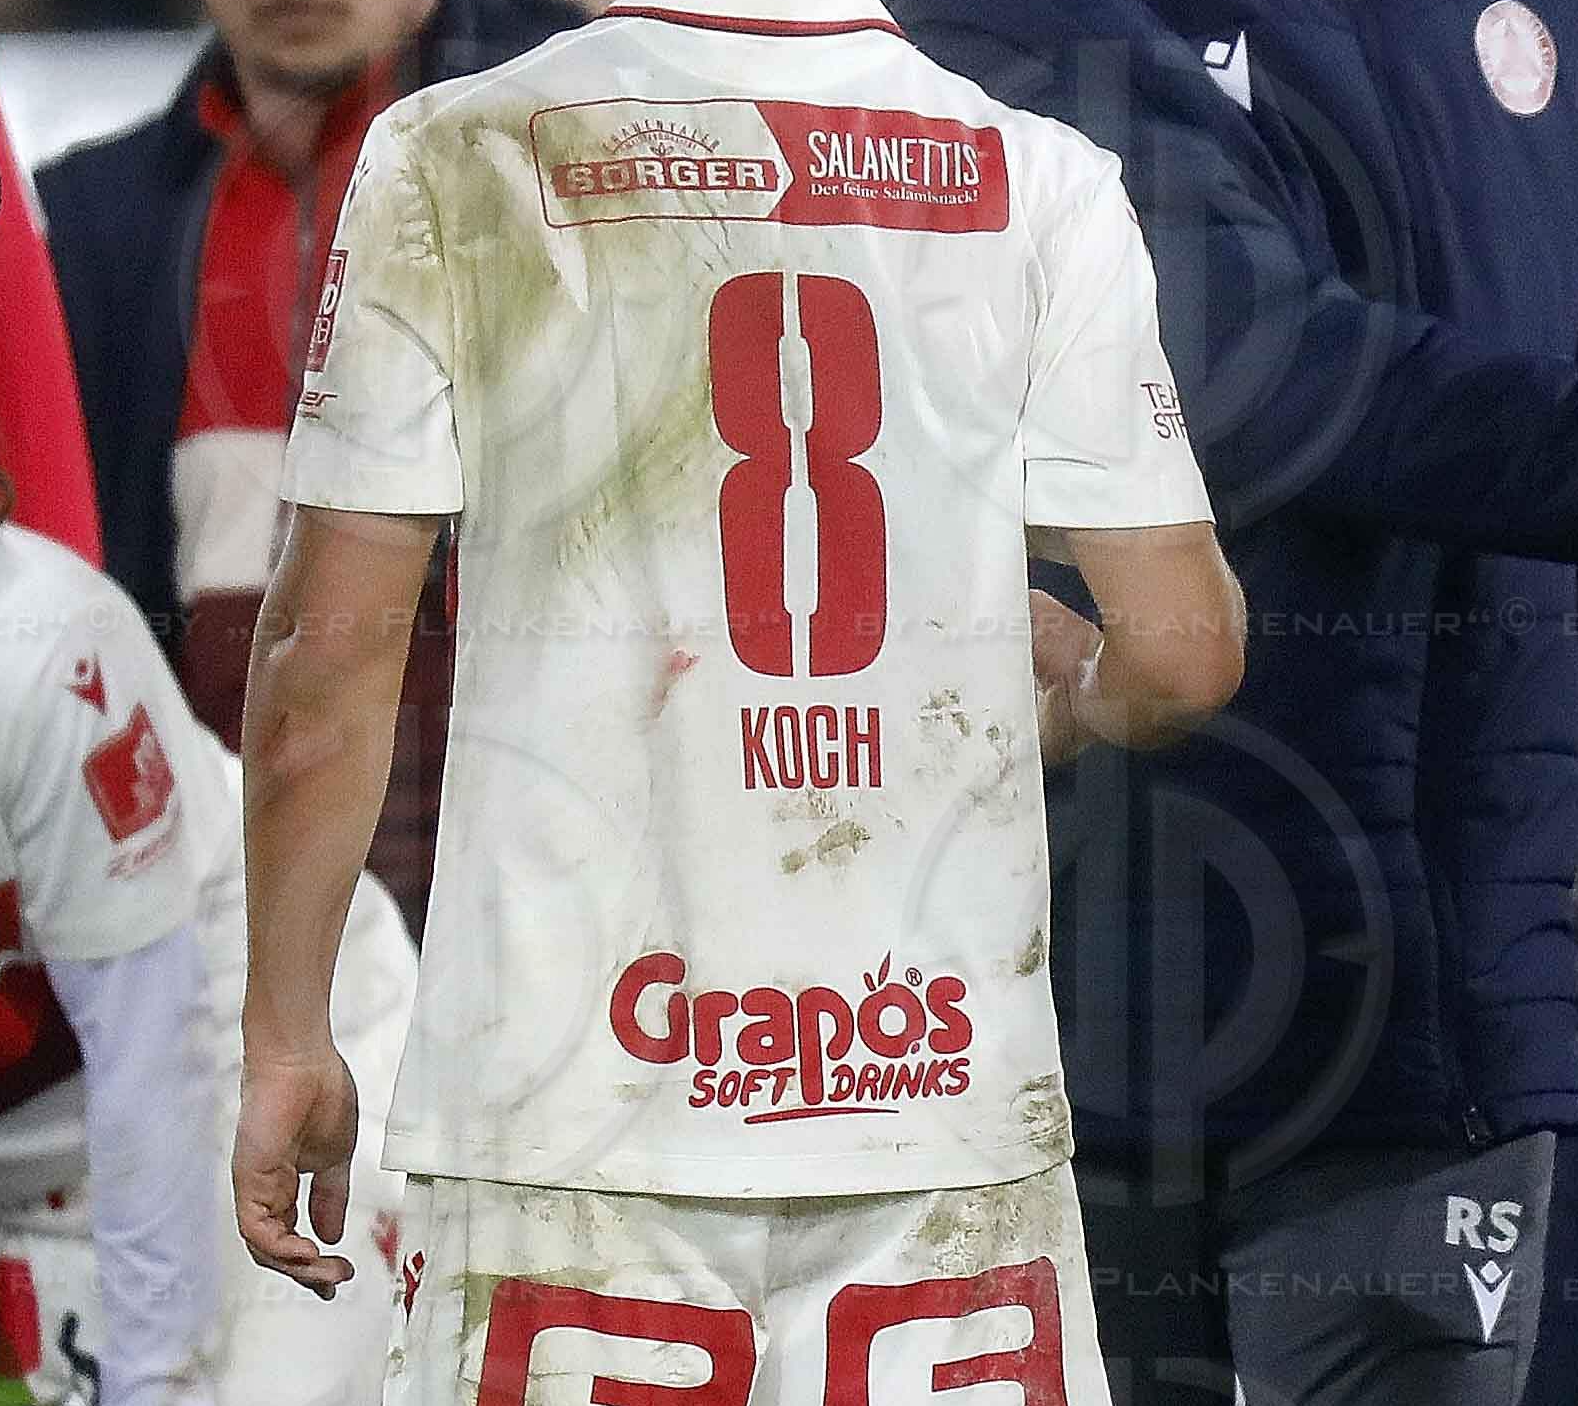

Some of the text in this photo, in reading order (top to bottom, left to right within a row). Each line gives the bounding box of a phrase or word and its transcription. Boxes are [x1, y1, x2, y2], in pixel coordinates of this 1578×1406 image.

[565, 159, 767, 192] SORGER
[808, 130, 980, 188] SALANETTIS
[810, 181, 979, 206] Der feine Salamisnack!
[708, 271, 887, 678] 8
[741, 704, 882, 791] KOCH
[688, 1057, 971, 1108] SOFT DRINKS
[1444, 1195, 1523, 1254] RS
